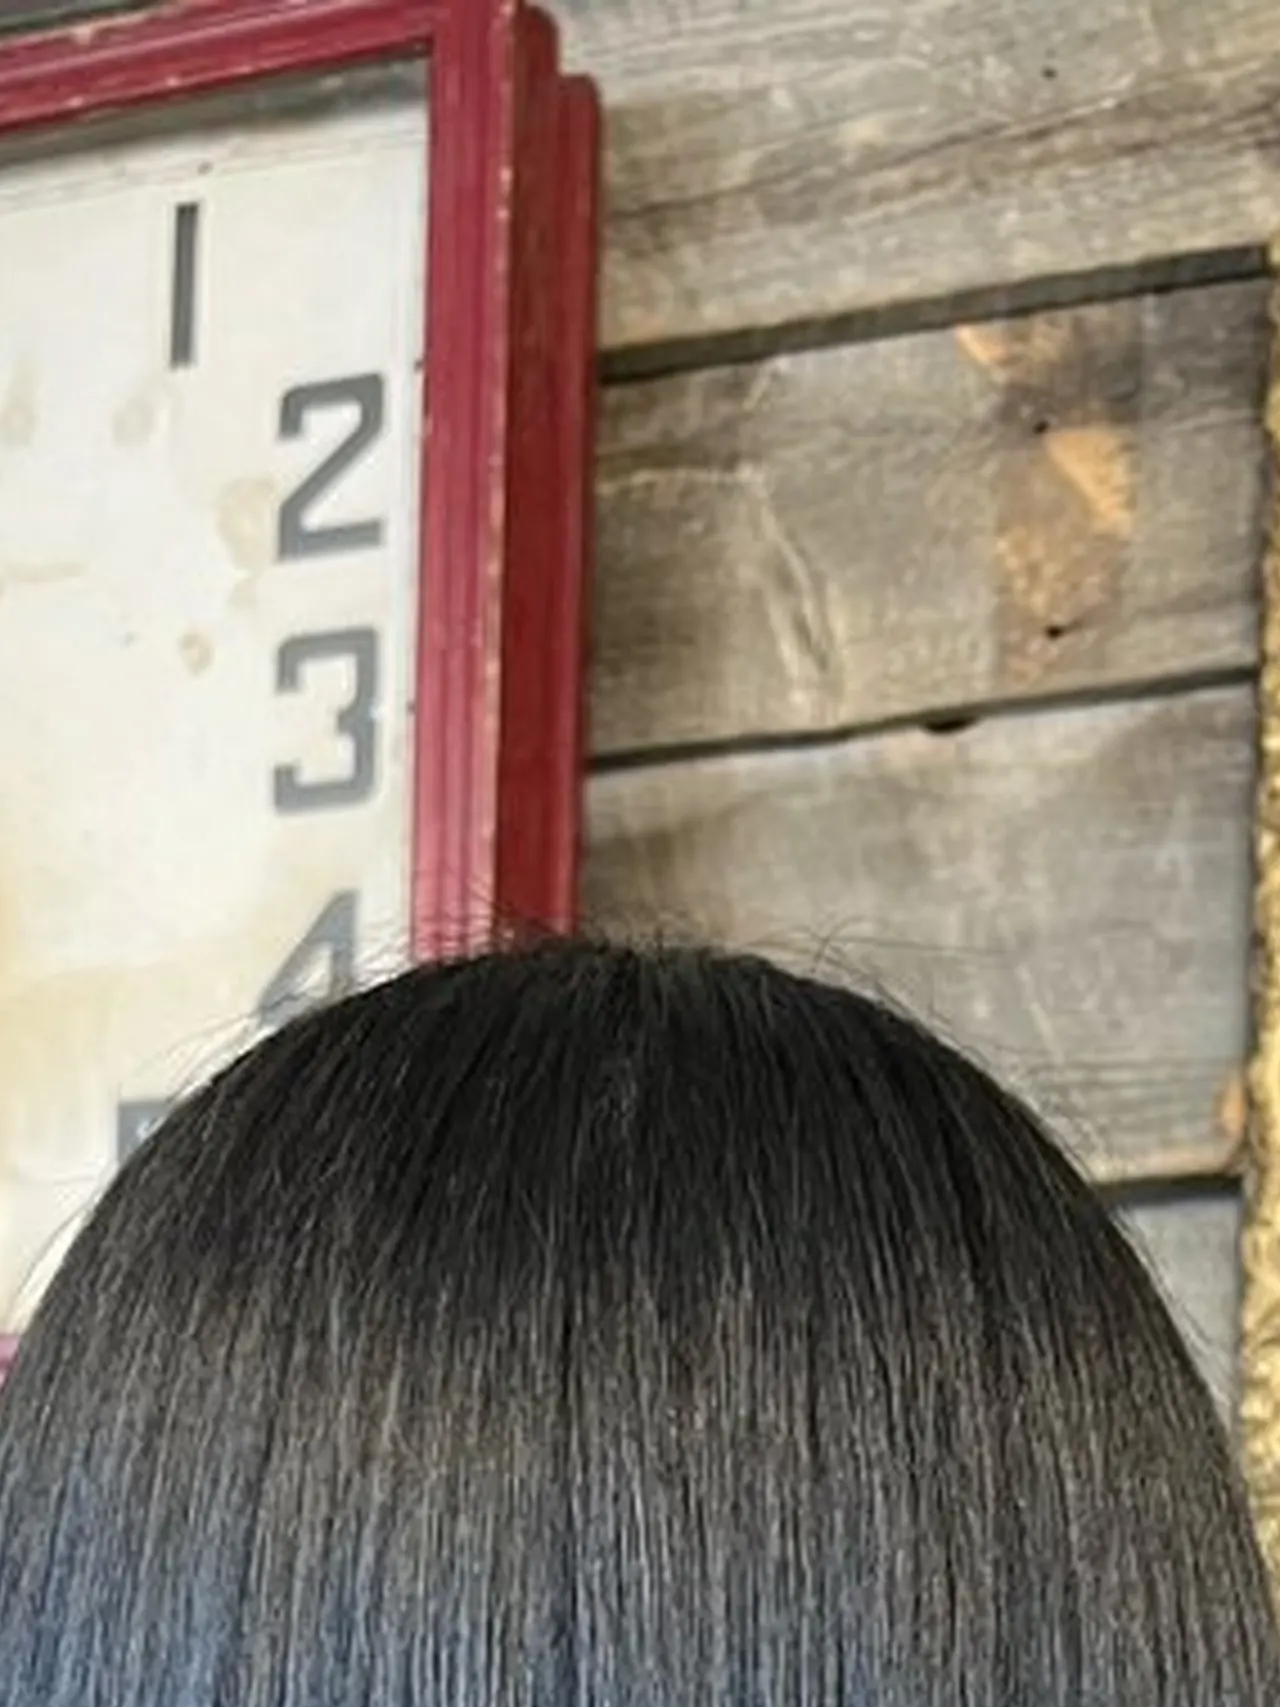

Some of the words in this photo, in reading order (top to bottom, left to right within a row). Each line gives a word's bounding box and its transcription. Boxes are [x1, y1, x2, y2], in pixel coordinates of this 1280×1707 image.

[169, 201, 200, 370] 1
[276, 372, 385, 561] 2
[273, 626, 379, 812] 3
